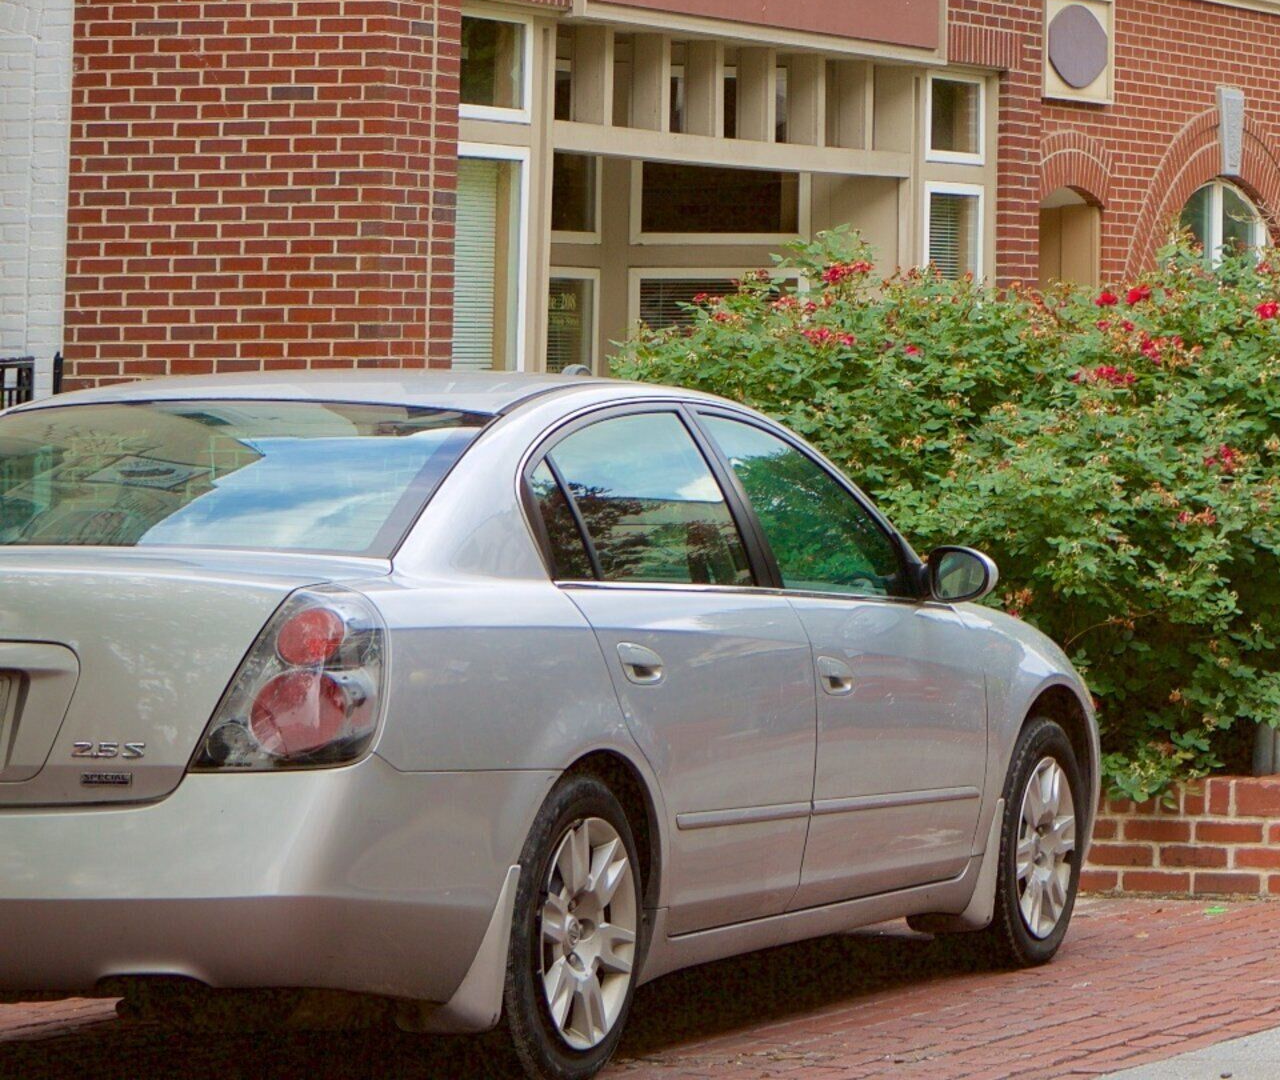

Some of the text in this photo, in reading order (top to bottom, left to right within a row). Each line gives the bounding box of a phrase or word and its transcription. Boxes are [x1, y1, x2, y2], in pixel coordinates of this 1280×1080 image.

[71, 741, 147, 759] 2.5 S
[82, 773, 130, 782] SPECIAL
